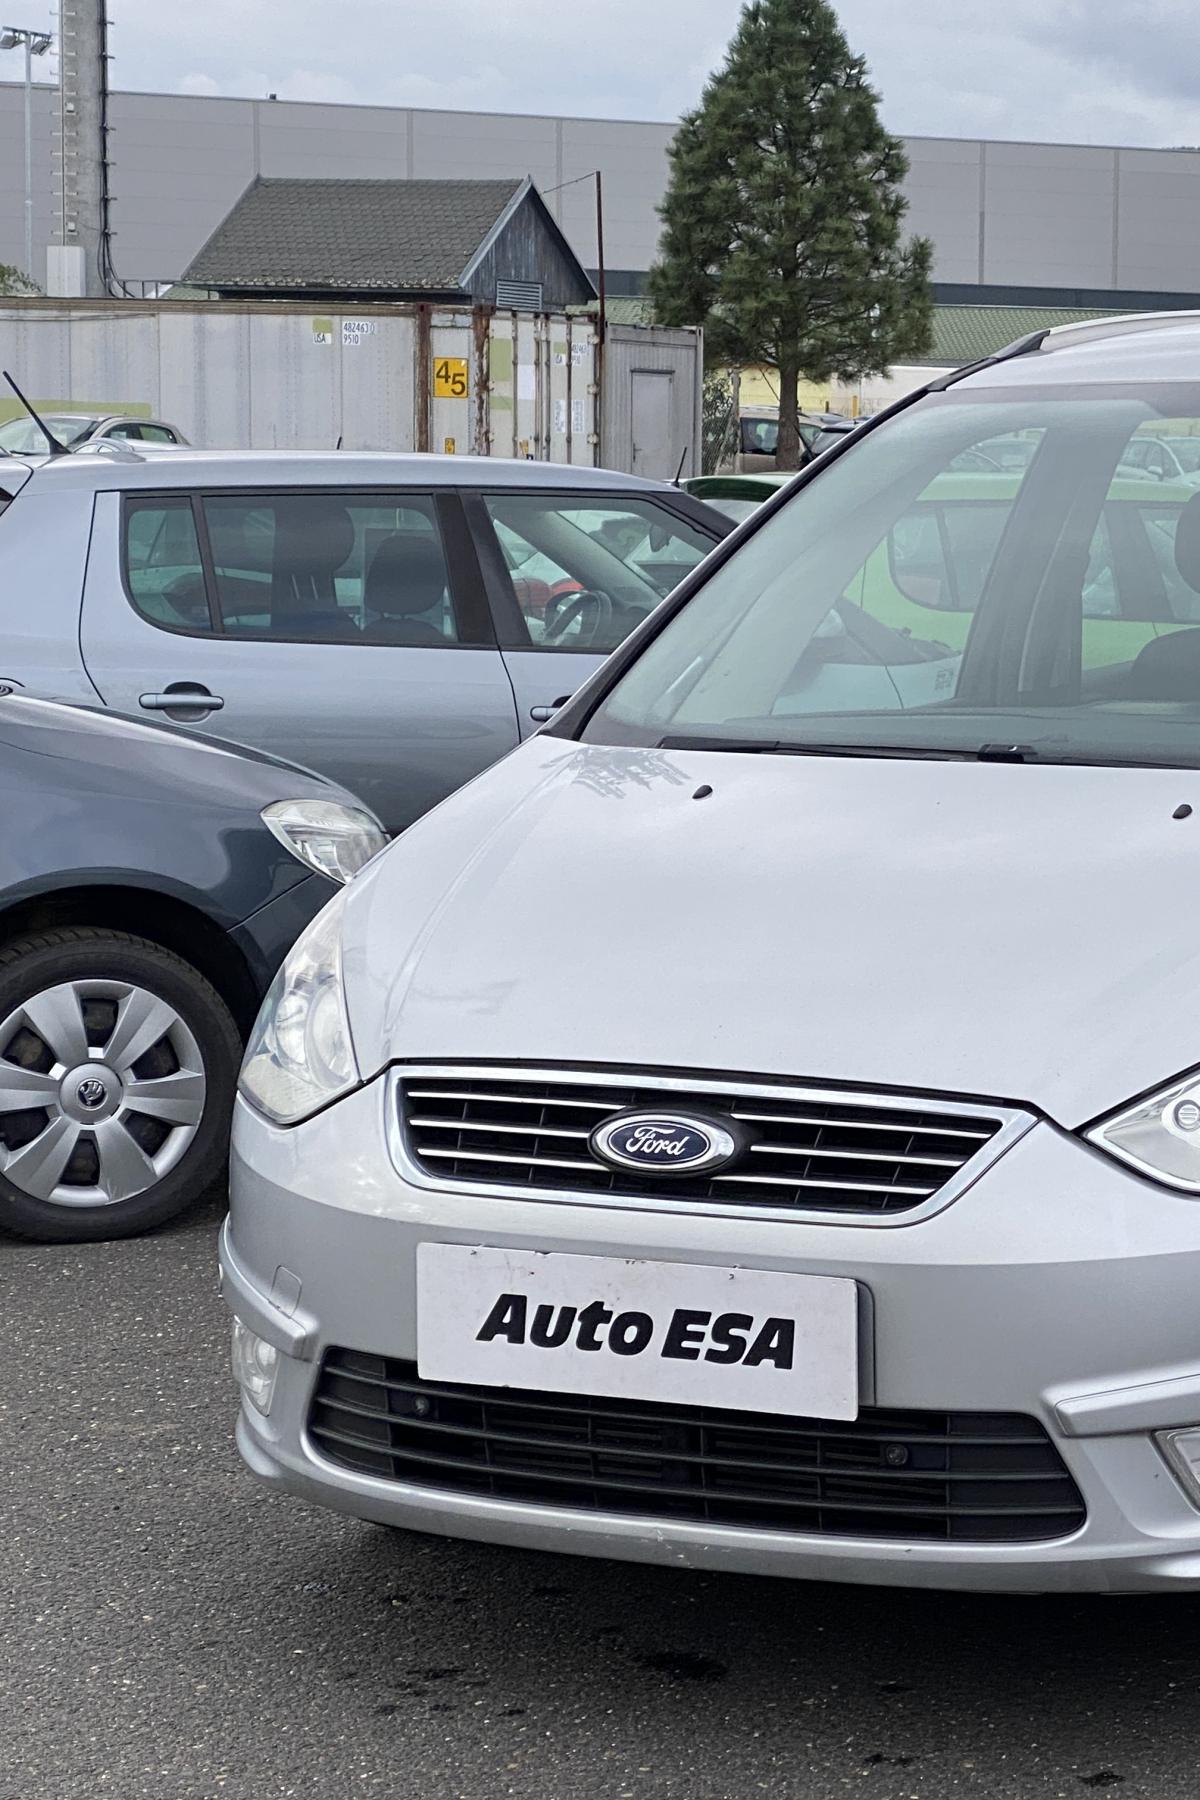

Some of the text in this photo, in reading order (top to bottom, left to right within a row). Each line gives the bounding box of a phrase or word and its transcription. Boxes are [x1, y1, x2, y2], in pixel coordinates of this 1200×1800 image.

[343, 333, 359, 345] 9510
[625, 1126, 691, 1156] Ford
[475, 1293, 796, 1370] Auto ESA
